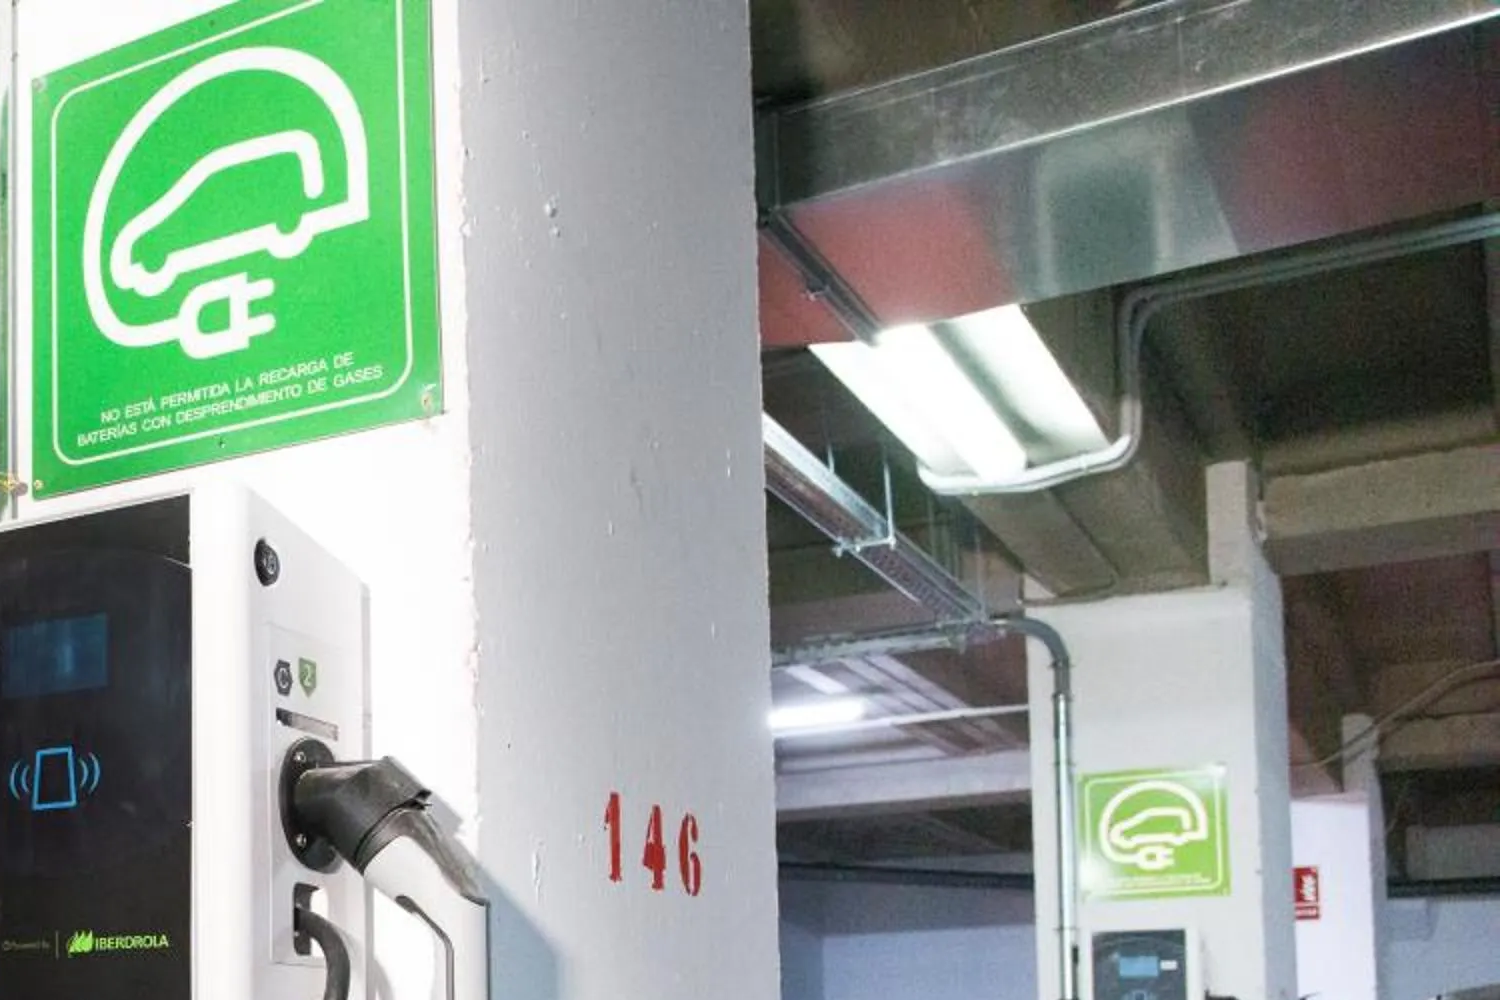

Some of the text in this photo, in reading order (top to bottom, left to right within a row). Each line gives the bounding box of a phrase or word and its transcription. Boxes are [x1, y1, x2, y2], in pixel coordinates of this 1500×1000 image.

[100, 408, 121, 423] NO
[160, 383, 231, 410] PERMITIDA
[234, 377, 254, 393] LA
[259, 358, 328, 386] RECARGA
[333, 352, 354, 369] DE
[141, 414, 171, 431] CON
[175, 384, 302, 424] DESPRENDIMIENTO
[307, 377, 327, 394] DE
[333, 365, 383, 388] GASES
[604, 791, 702, 897] 146
[95, 934, 169, 950] IBERDROLA
